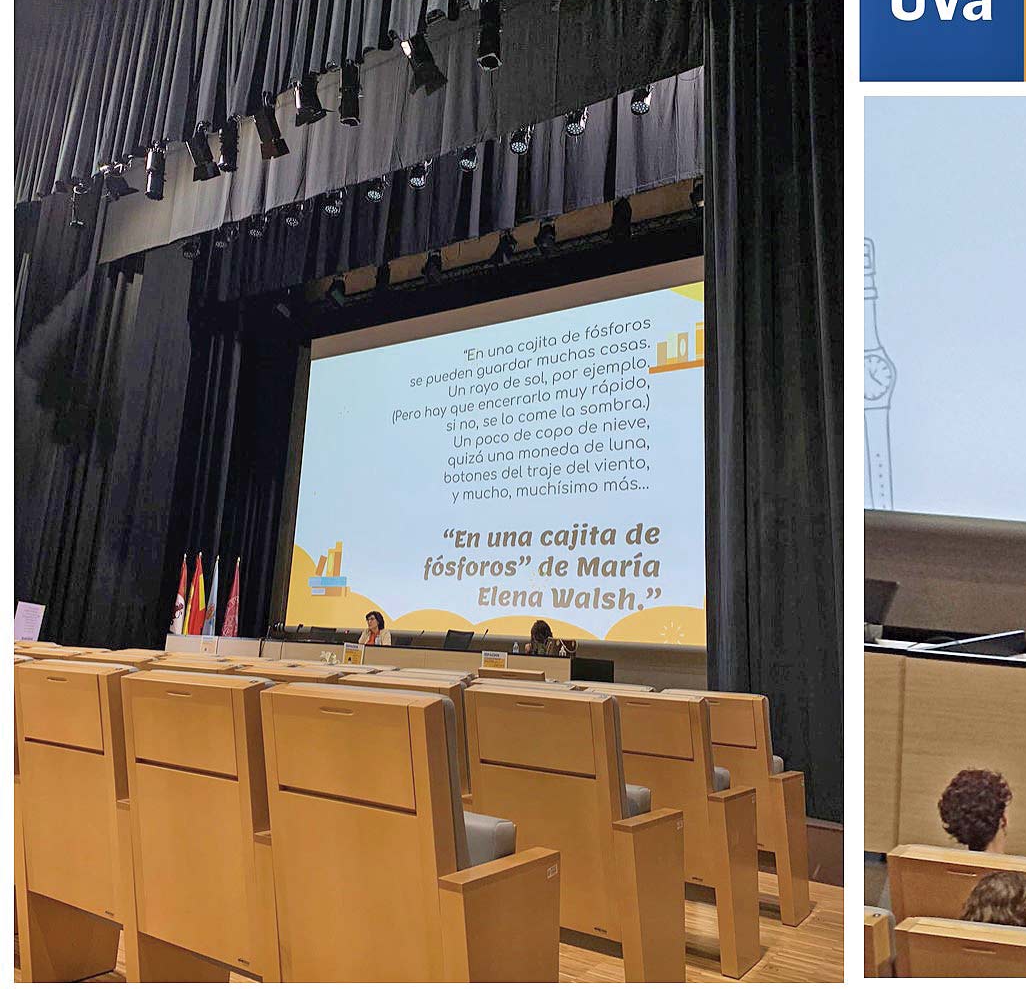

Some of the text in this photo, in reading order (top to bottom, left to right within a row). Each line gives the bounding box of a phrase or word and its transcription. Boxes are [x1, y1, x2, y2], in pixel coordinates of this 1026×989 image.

[488, 345, 514, 356] una
[518, 335, 557, 353] cajita
[561, 332, 580, 343] de
[585, 318, 651, 339] fósforos
[410, 339, 651, 388] se pueden guardar muchas cosas.
[448, 385, 466, 397] Un
[469, 380, 499, 395] rayo
[503, 377, 521, 389] de
[524, 373, 548, 386] sol,
[552, 369, 578, 385] por
[392, 376, 651, 425] (Pero hay que encerrarlo muy rápido,
[447, 394, 651, 432] si no, se lo come la sombra.)
[453, 415, 651, 449] Un poco de copo de nieve,
[448, 436, 651, 468] quizá una moneda de luna,
[444, 457, 651, 484] botones del traje del viento,
[452, 477, 650, 503] y mucho, muchísimo más...
[488, 530, 533, 548] una
[540, 524, 617, 550] cajita
[625, 523, 660, 545] de
[538, 555, 569, 577] de
[577, 553, 660, 577] María
[478, 586, 543, 608] Elena
